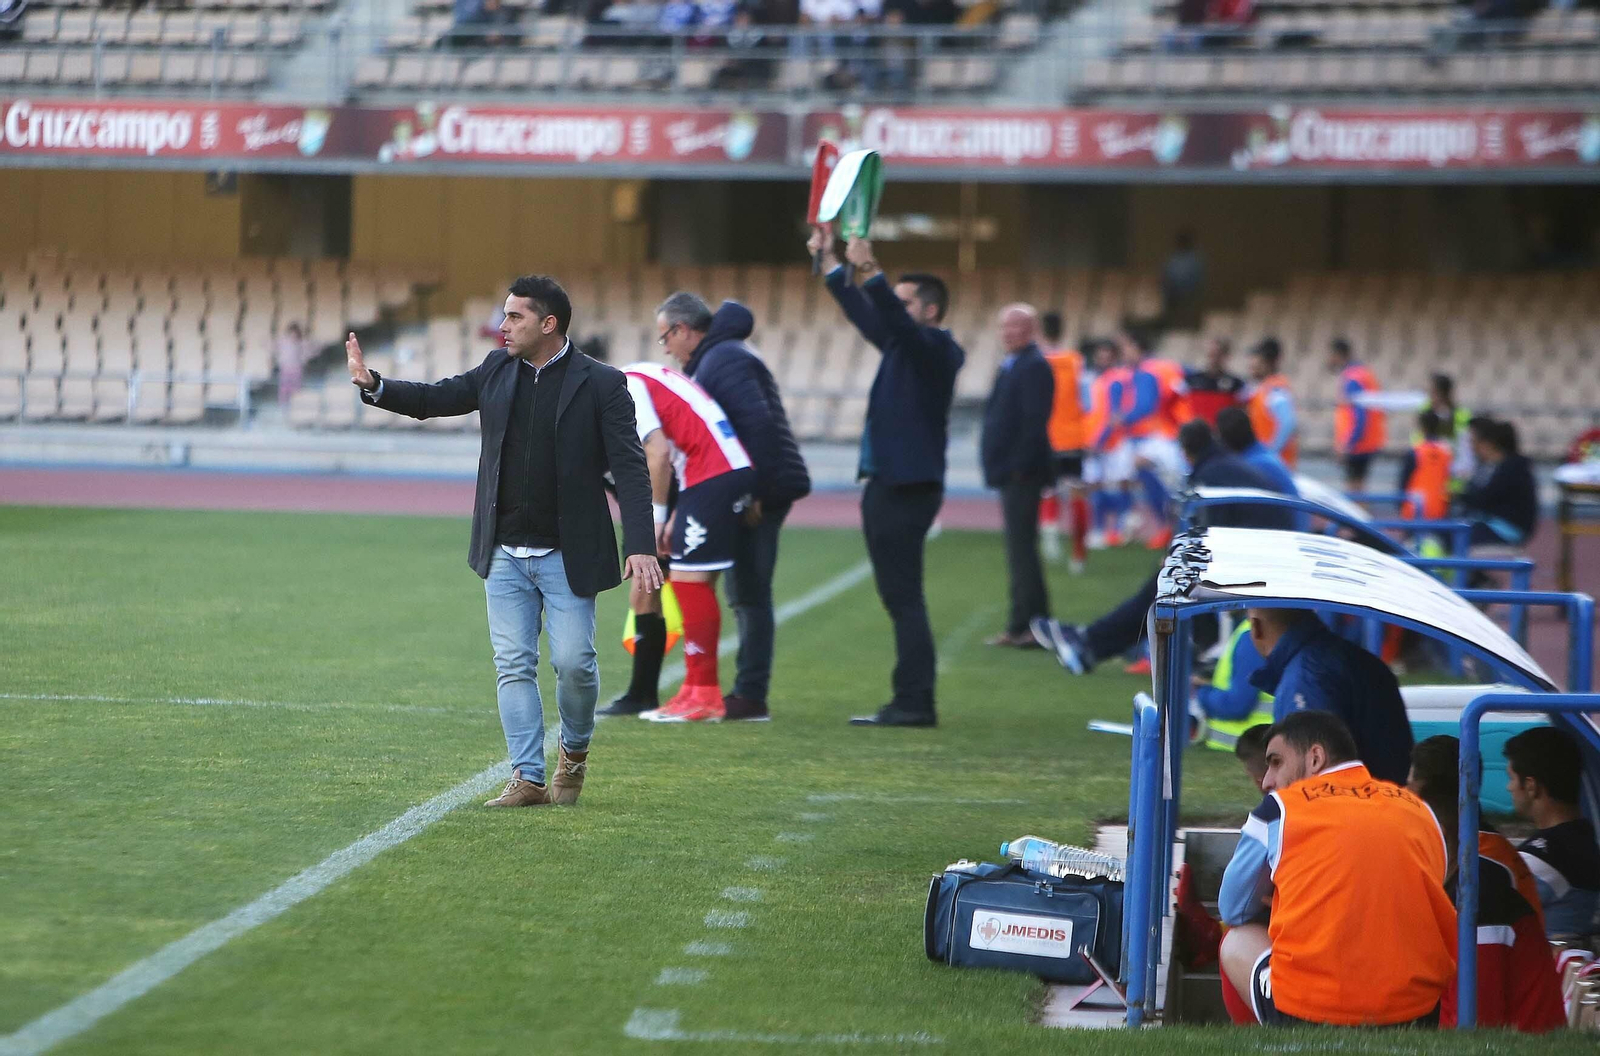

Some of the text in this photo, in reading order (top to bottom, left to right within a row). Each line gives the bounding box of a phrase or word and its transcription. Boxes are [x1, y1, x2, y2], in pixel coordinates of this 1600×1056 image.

[5, 99, 193, 156] Cruzcampo
[438, 105, 623, 162] Cruzcampo
[1001, 924, 1066, 942] JMEDIS
